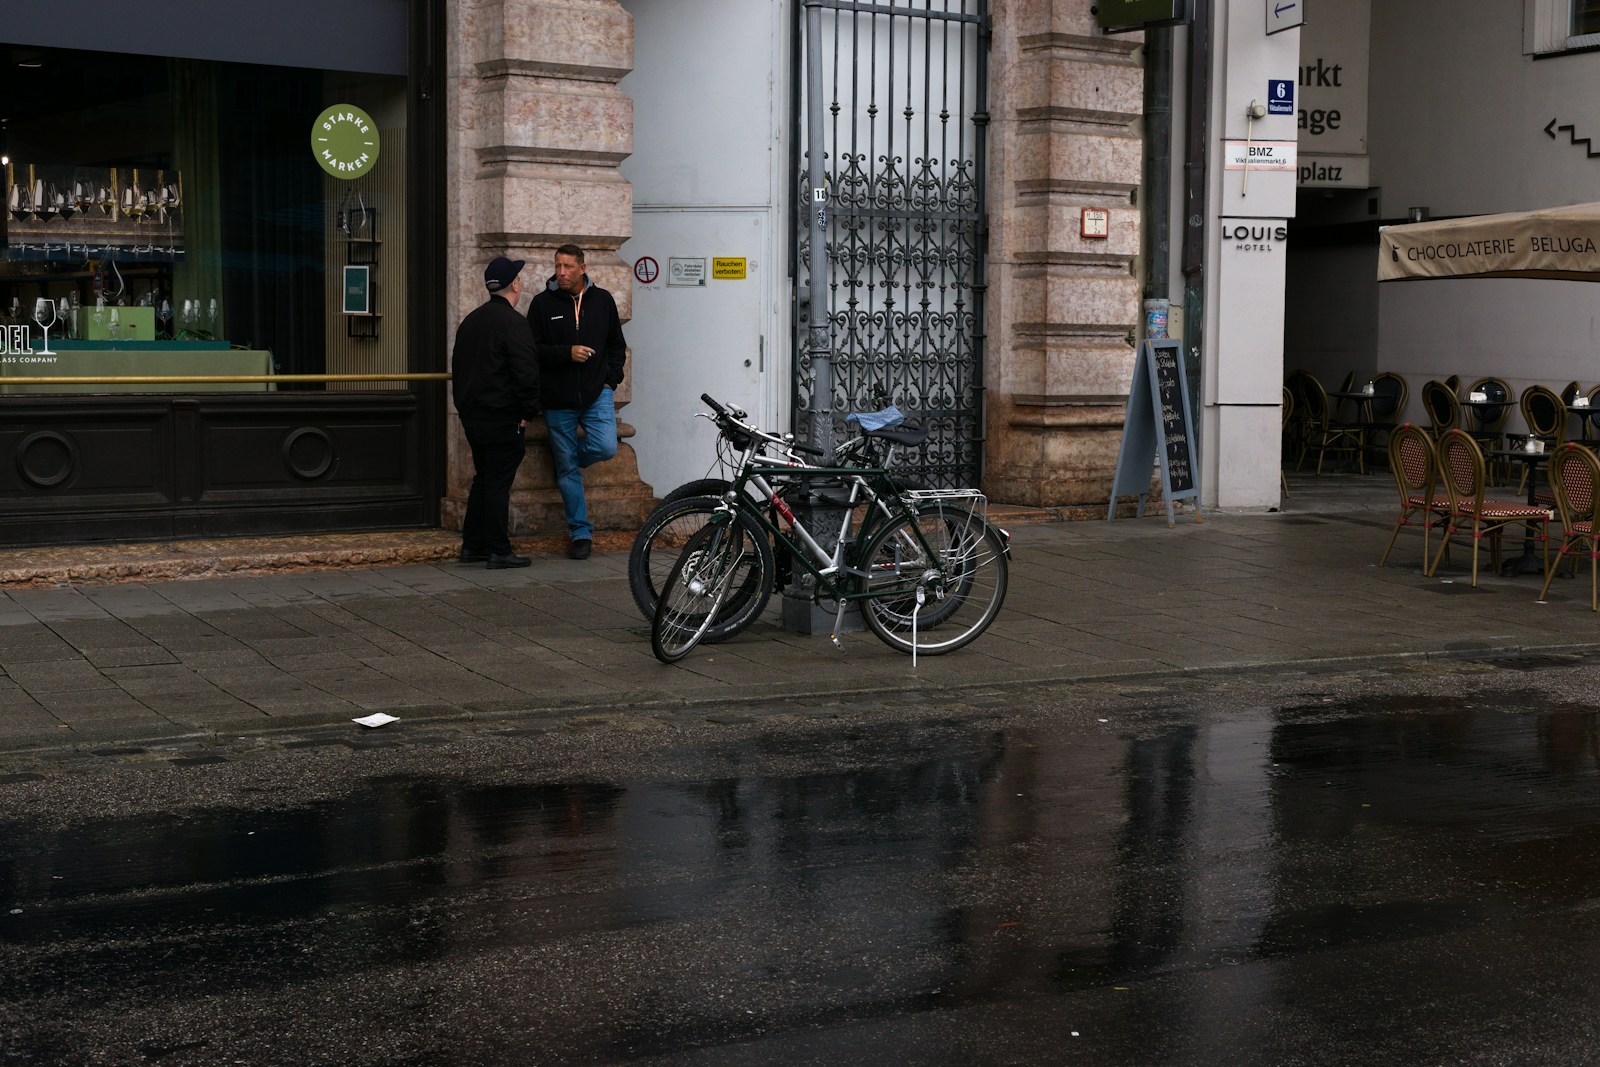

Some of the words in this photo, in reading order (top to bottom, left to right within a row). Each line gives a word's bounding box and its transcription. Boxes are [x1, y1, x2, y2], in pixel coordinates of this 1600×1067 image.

[1276, 82, 1286, 98] 6
[322, 112, 369, 134] STARKE
[322, 149, 369, 172] MARKEN
[1248, 147, 1273, 157] BMZ
[1296, 162, 1342, 184] platz
[1222, 225, 1288, 242] LOUIS
[1236, 244, 1272, 252] HOTEL
[1407, 238, 1516, 261] CHOCOLATERIE
[1531, 237, 1597, 254] BELUGA
